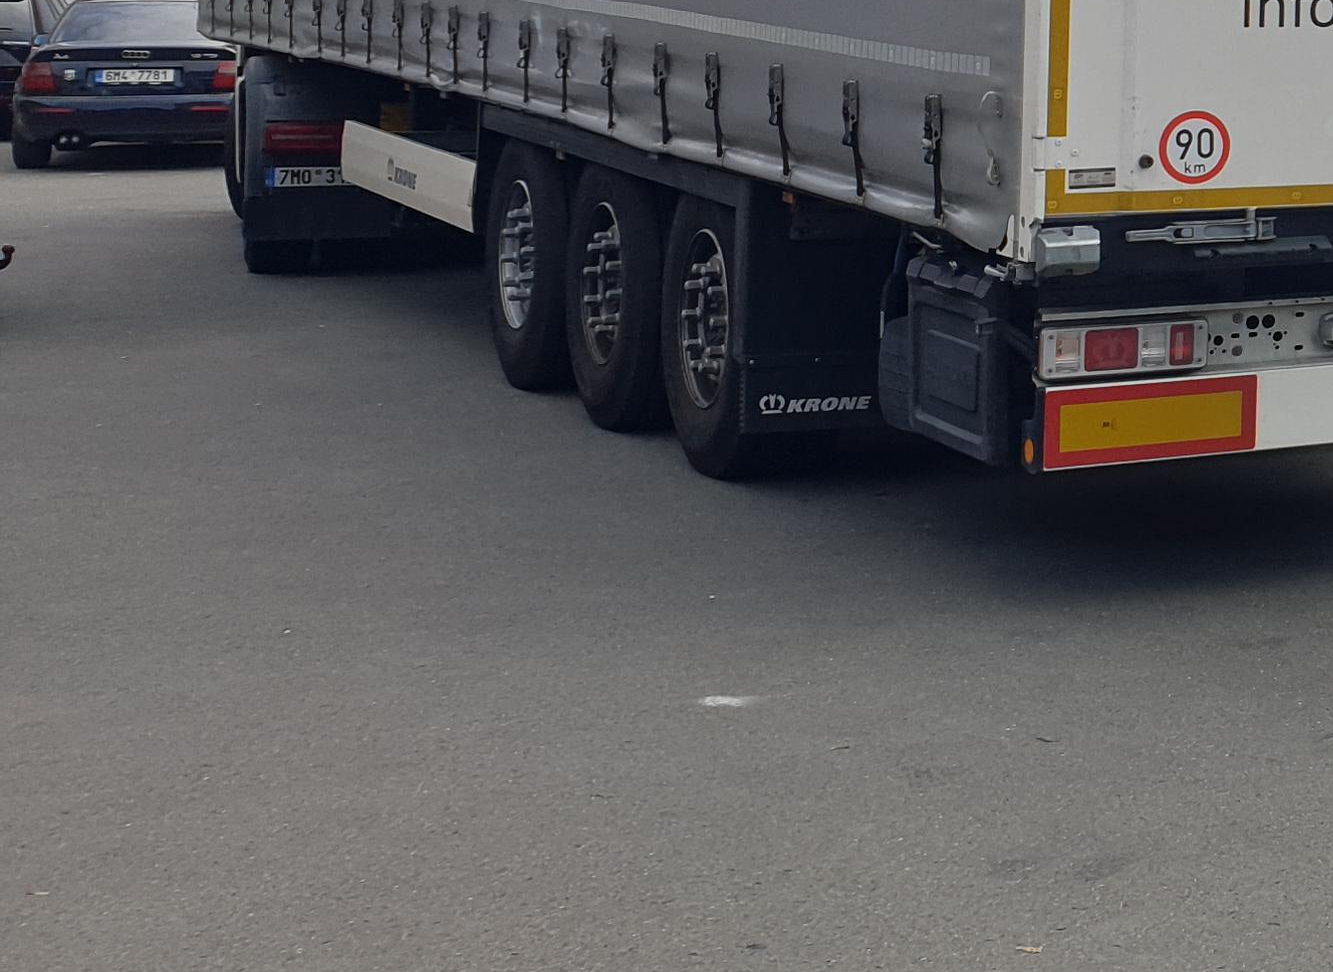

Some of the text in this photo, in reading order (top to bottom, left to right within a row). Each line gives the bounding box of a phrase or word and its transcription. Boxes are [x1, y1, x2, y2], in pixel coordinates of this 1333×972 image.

[136, 69, 168, 81] 7781
[1176, 127, 1214, 160] 90
[1184, 162, 1206, 173] km
[787, 395, 872, 413] KRONE
